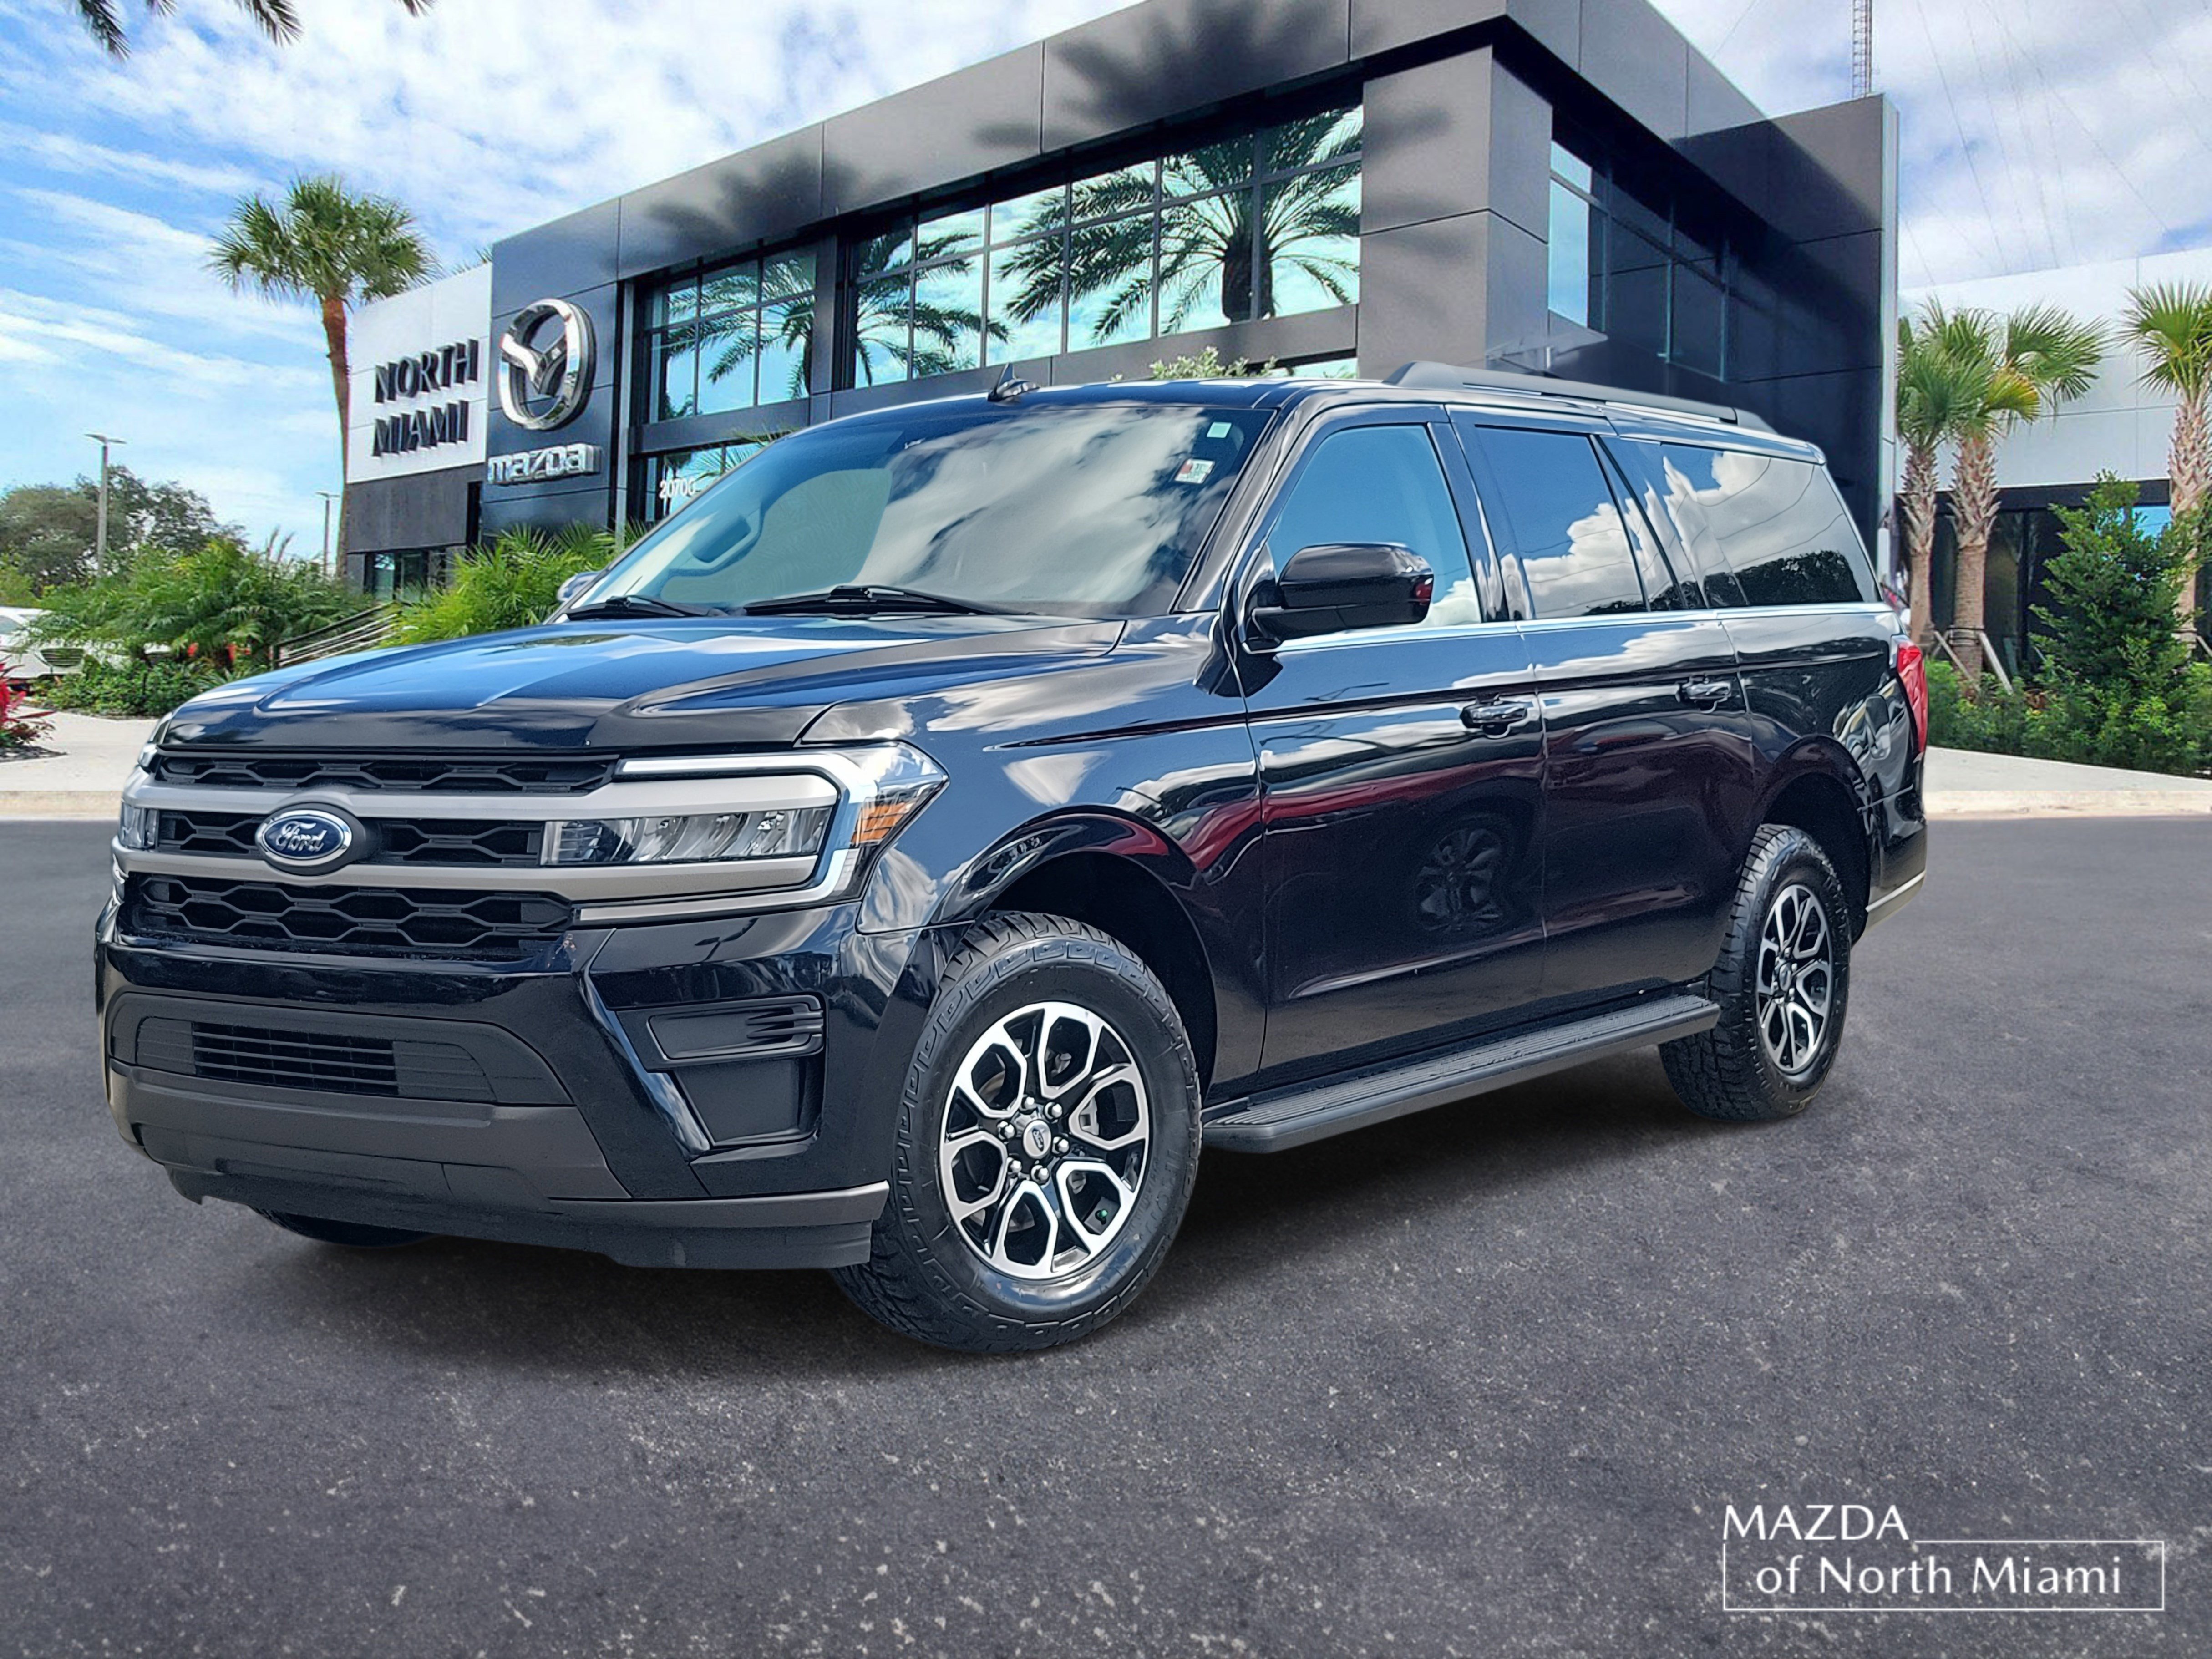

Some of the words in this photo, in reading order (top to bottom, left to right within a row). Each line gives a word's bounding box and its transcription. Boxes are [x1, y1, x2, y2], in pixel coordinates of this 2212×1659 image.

[375, 338, 479, 404] NORTH
[372, 400, 469, 457] MIAMI
[276, 821, 328, 852] Ford
